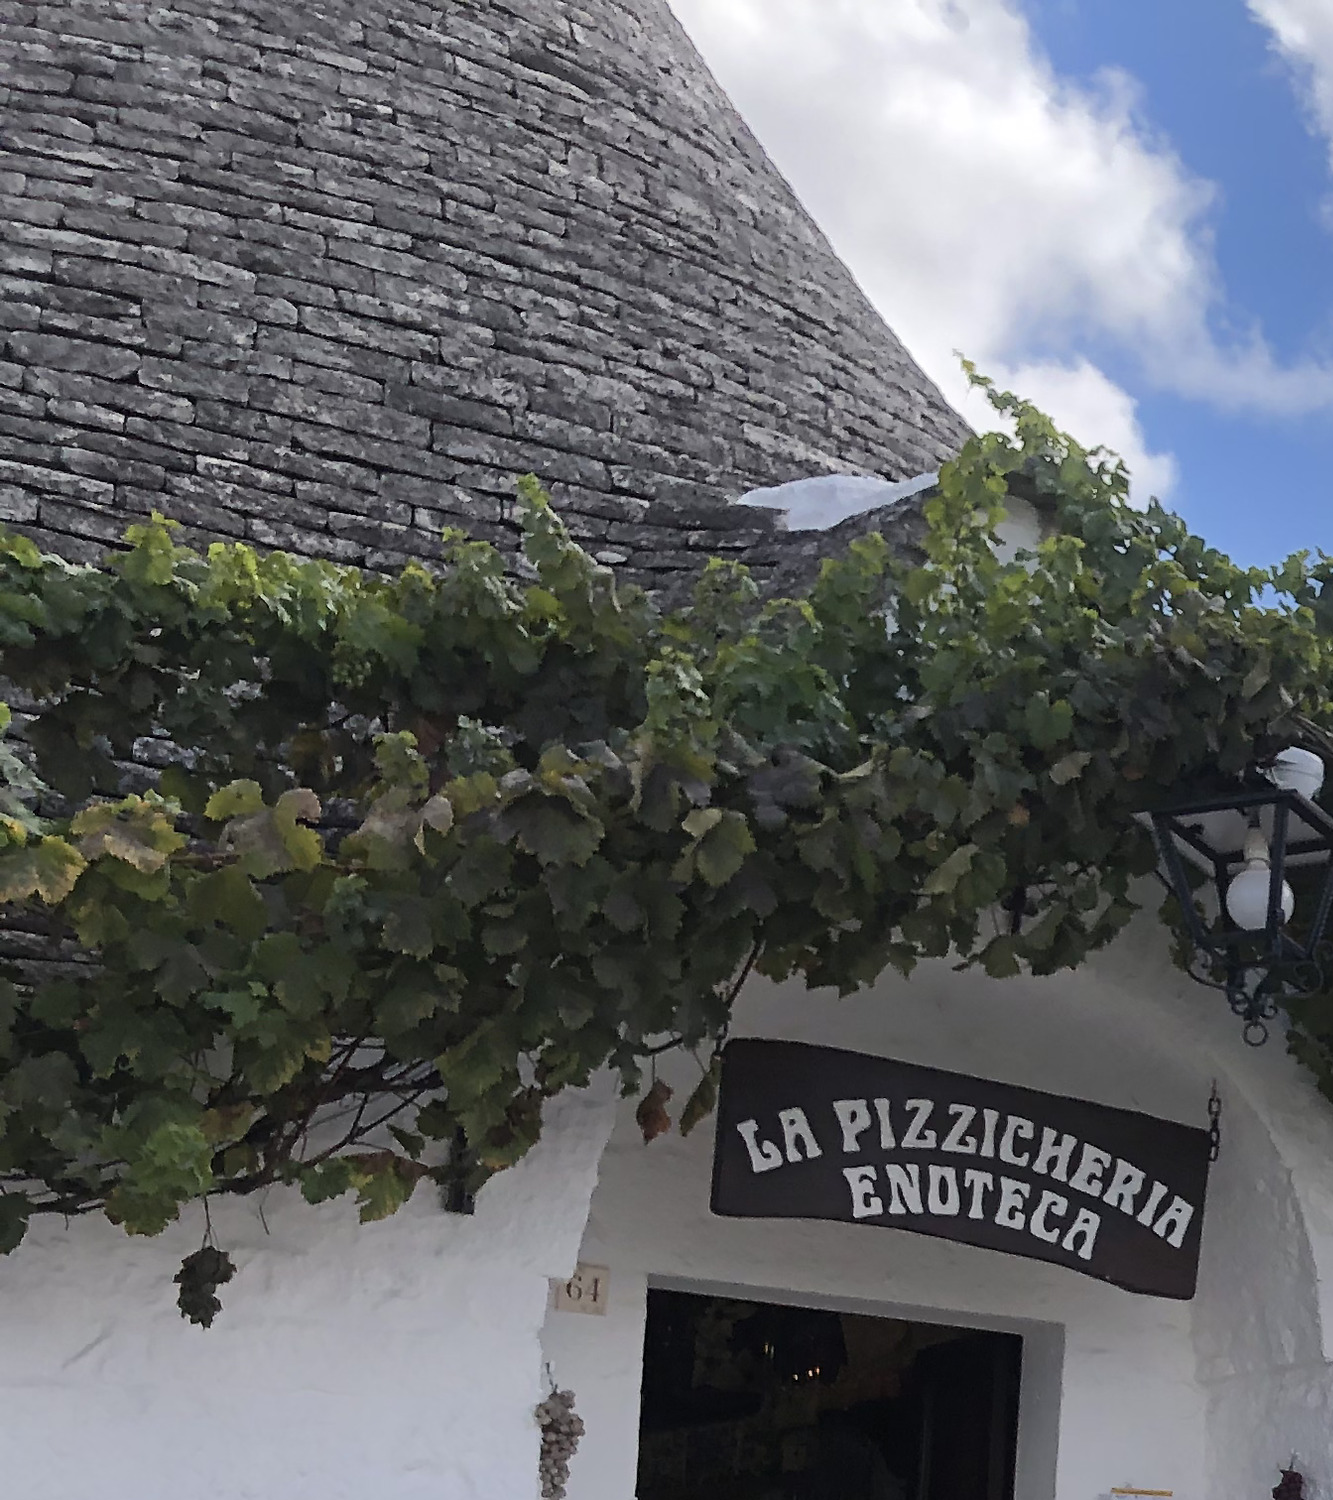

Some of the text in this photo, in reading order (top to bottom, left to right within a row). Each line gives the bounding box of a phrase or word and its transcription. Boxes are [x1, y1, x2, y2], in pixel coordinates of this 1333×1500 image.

[737, 1097, 1194, 1249] LA PIZZICHERIA
[843, 1164, 1102, 1260] ENOTECA
